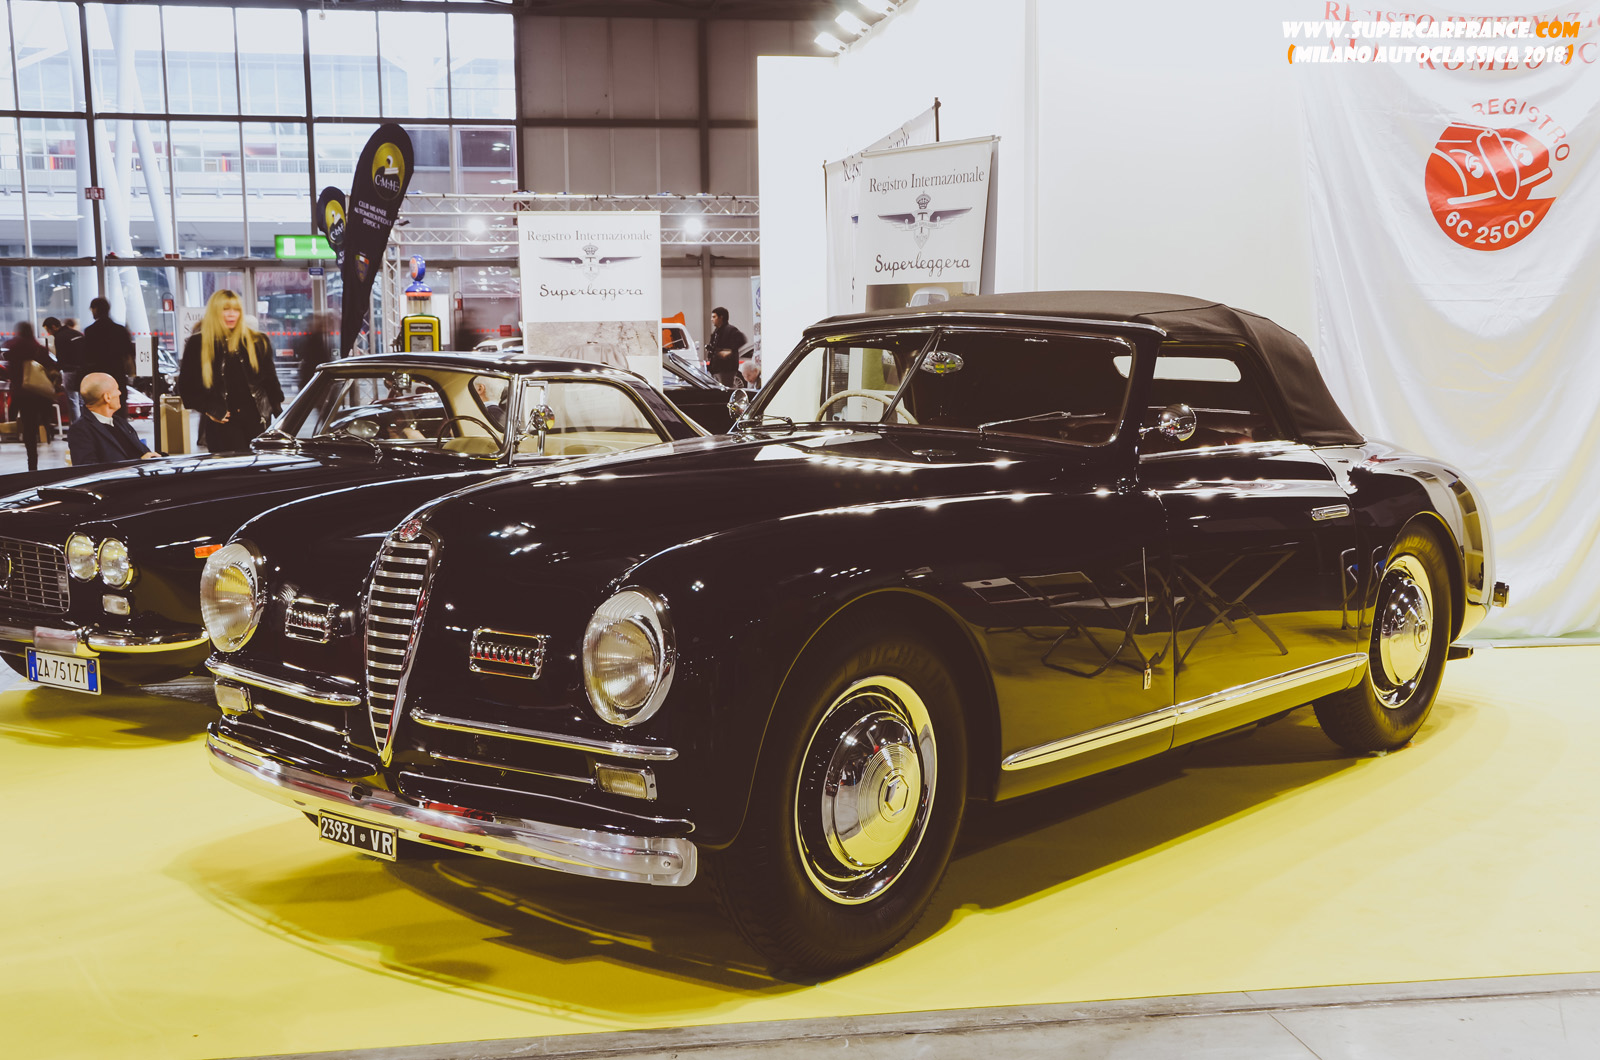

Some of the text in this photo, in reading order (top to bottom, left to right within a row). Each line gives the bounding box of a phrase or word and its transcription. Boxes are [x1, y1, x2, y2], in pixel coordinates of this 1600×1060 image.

[869, 166, 985, 195] Registro Internazionale
[527, 229, 652, 243] Registro Internazionale
[1445, 210, 1535, 244] 6C 2500
[875, 251, 971, 278] Superleggera
[539, 283, 644, 301] Superleggera
[37, 657, 50, 677] ZA
[52, 660, 86, 684] 751ZT
[321, 817, 392, 855] 23931 VR
